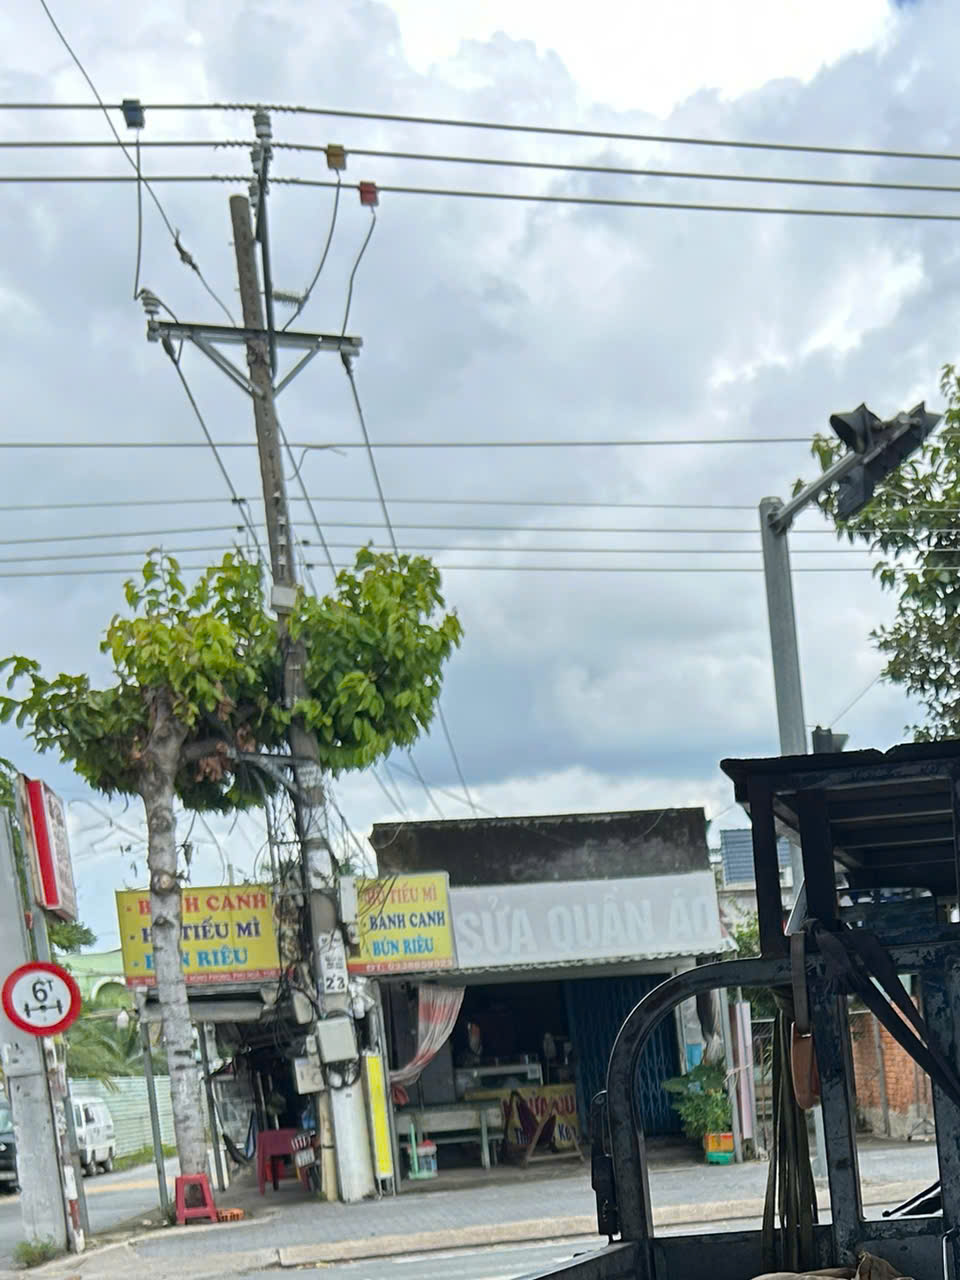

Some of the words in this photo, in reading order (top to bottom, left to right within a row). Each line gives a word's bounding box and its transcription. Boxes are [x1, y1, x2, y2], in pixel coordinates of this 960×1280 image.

[206, 892, 267, 912] CANH
[183, 916, 229, 941] TIẾU
[237, 916, 261, 938] MÌ
[409, 911, 446, 928] CANH
[457, 895, 537, 954] SỬA
[547, 886, 657, 949] QUẦN
[197, 944, 248, 967] RIÊU
